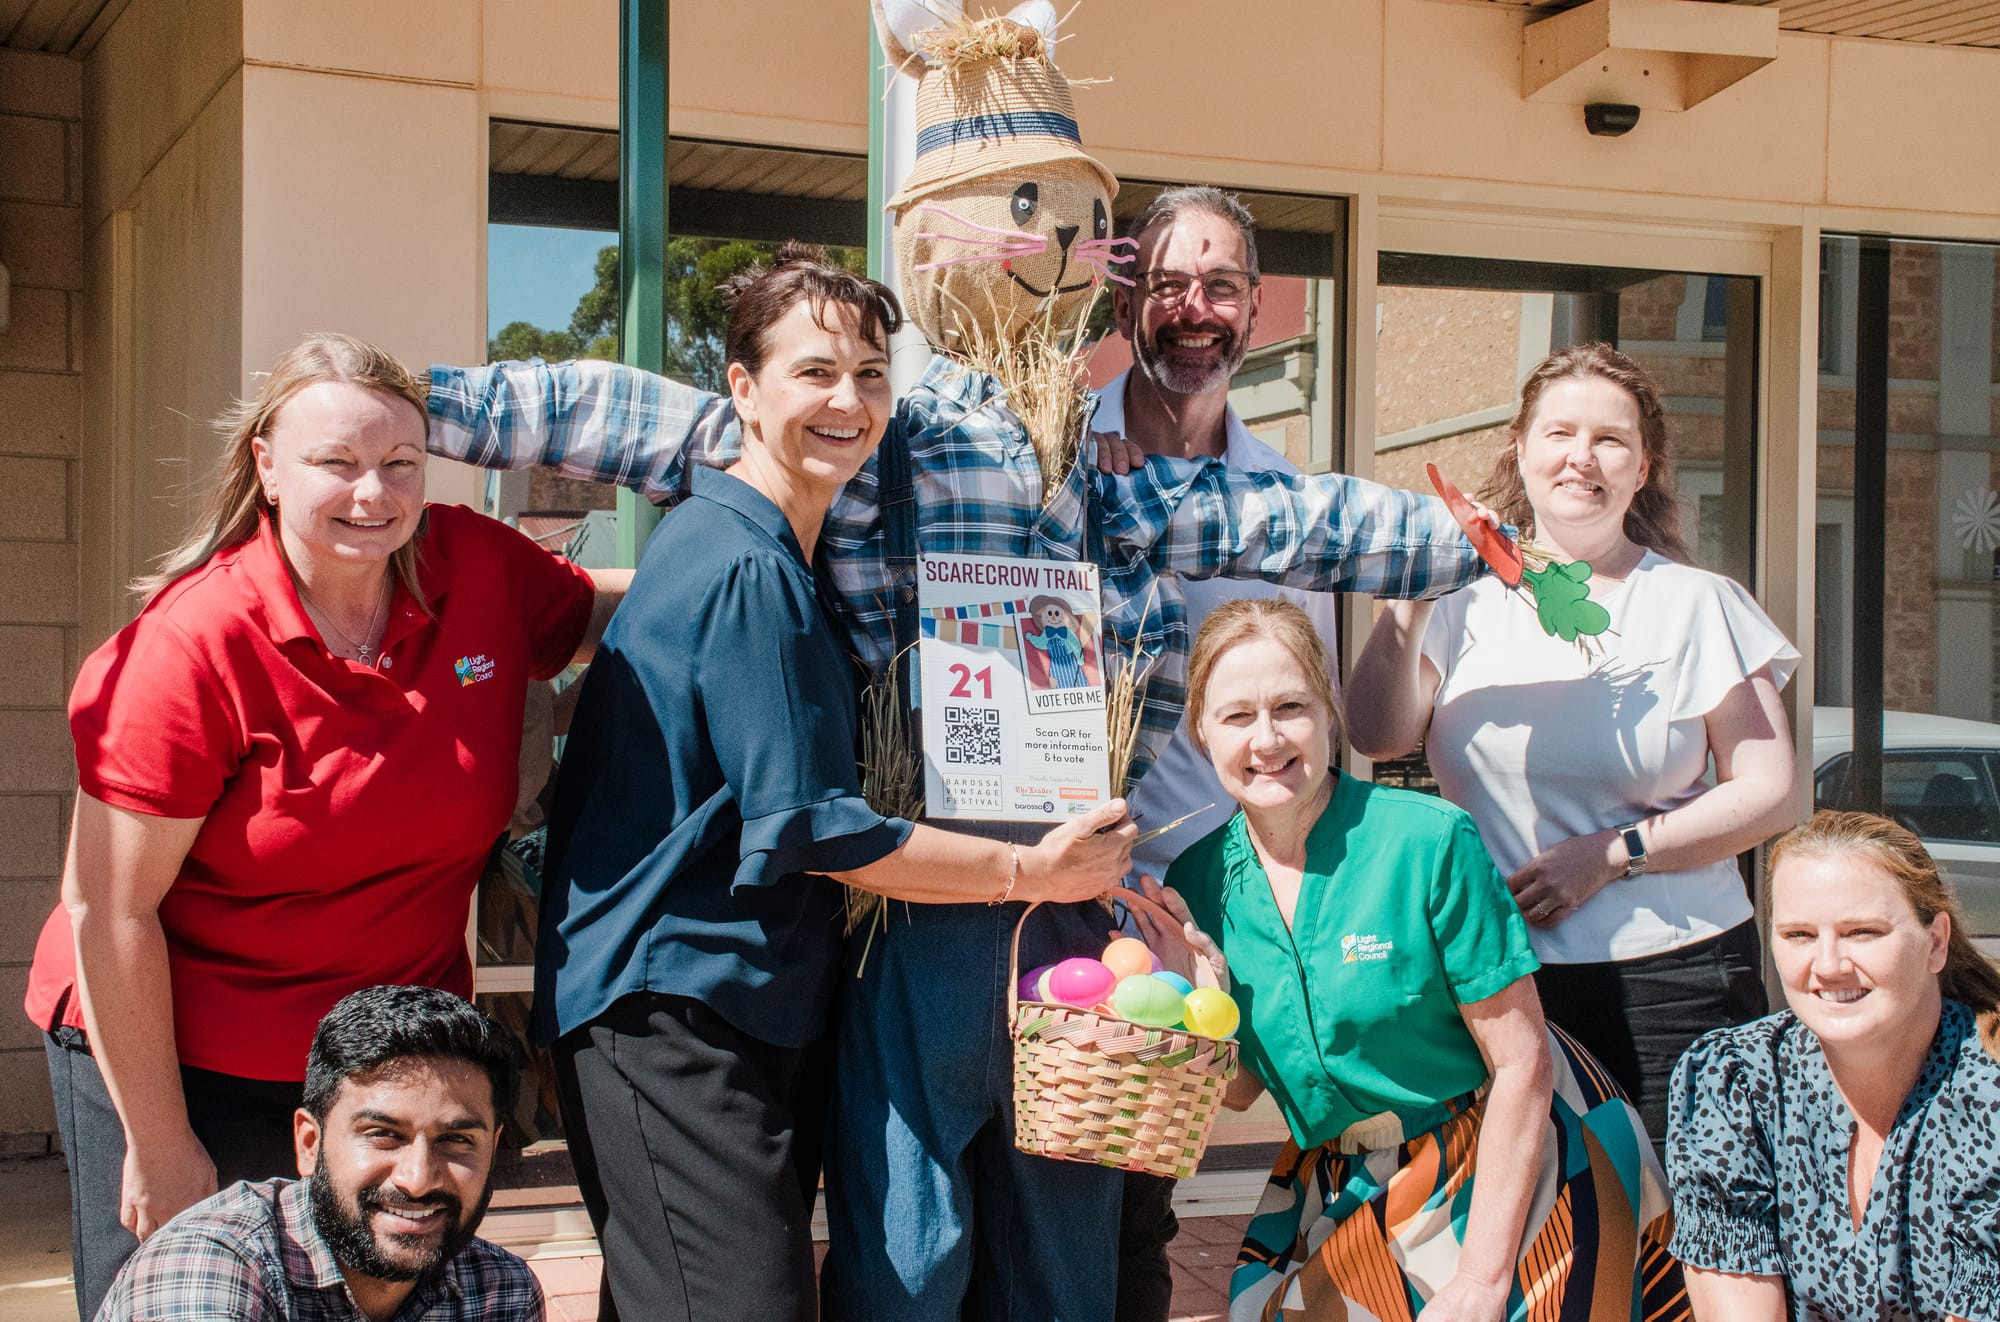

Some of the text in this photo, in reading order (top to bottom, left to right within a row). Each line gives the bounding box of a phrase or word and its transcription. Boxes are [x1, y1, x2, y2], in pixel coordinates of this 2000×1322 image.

[925, 561, 1093, 591] SCARECROW TRAIL
[469, 654, 486, 665] Light
[948, 662, 993, 699] 21
[1035, 690, 1103, 708] VOTE FOR ME
[1035, 727, 1092, 739] Scan QR for
[1024, 741, 1104, 752] more information
[1044, 752, 1086, 763] & to vote
[945, 778, 1000, 787] BAROSSA
[945, 787, 1000, 797] VINTAGE
[946, 797, 1000, 806] FESTIVAL
[1014, 802, 1043, 810] barossa
[1356, 935, 1378, 945] Light
[1357, 941, 1393, 952] Regional
[1358, 951, 1388, 961] Council
